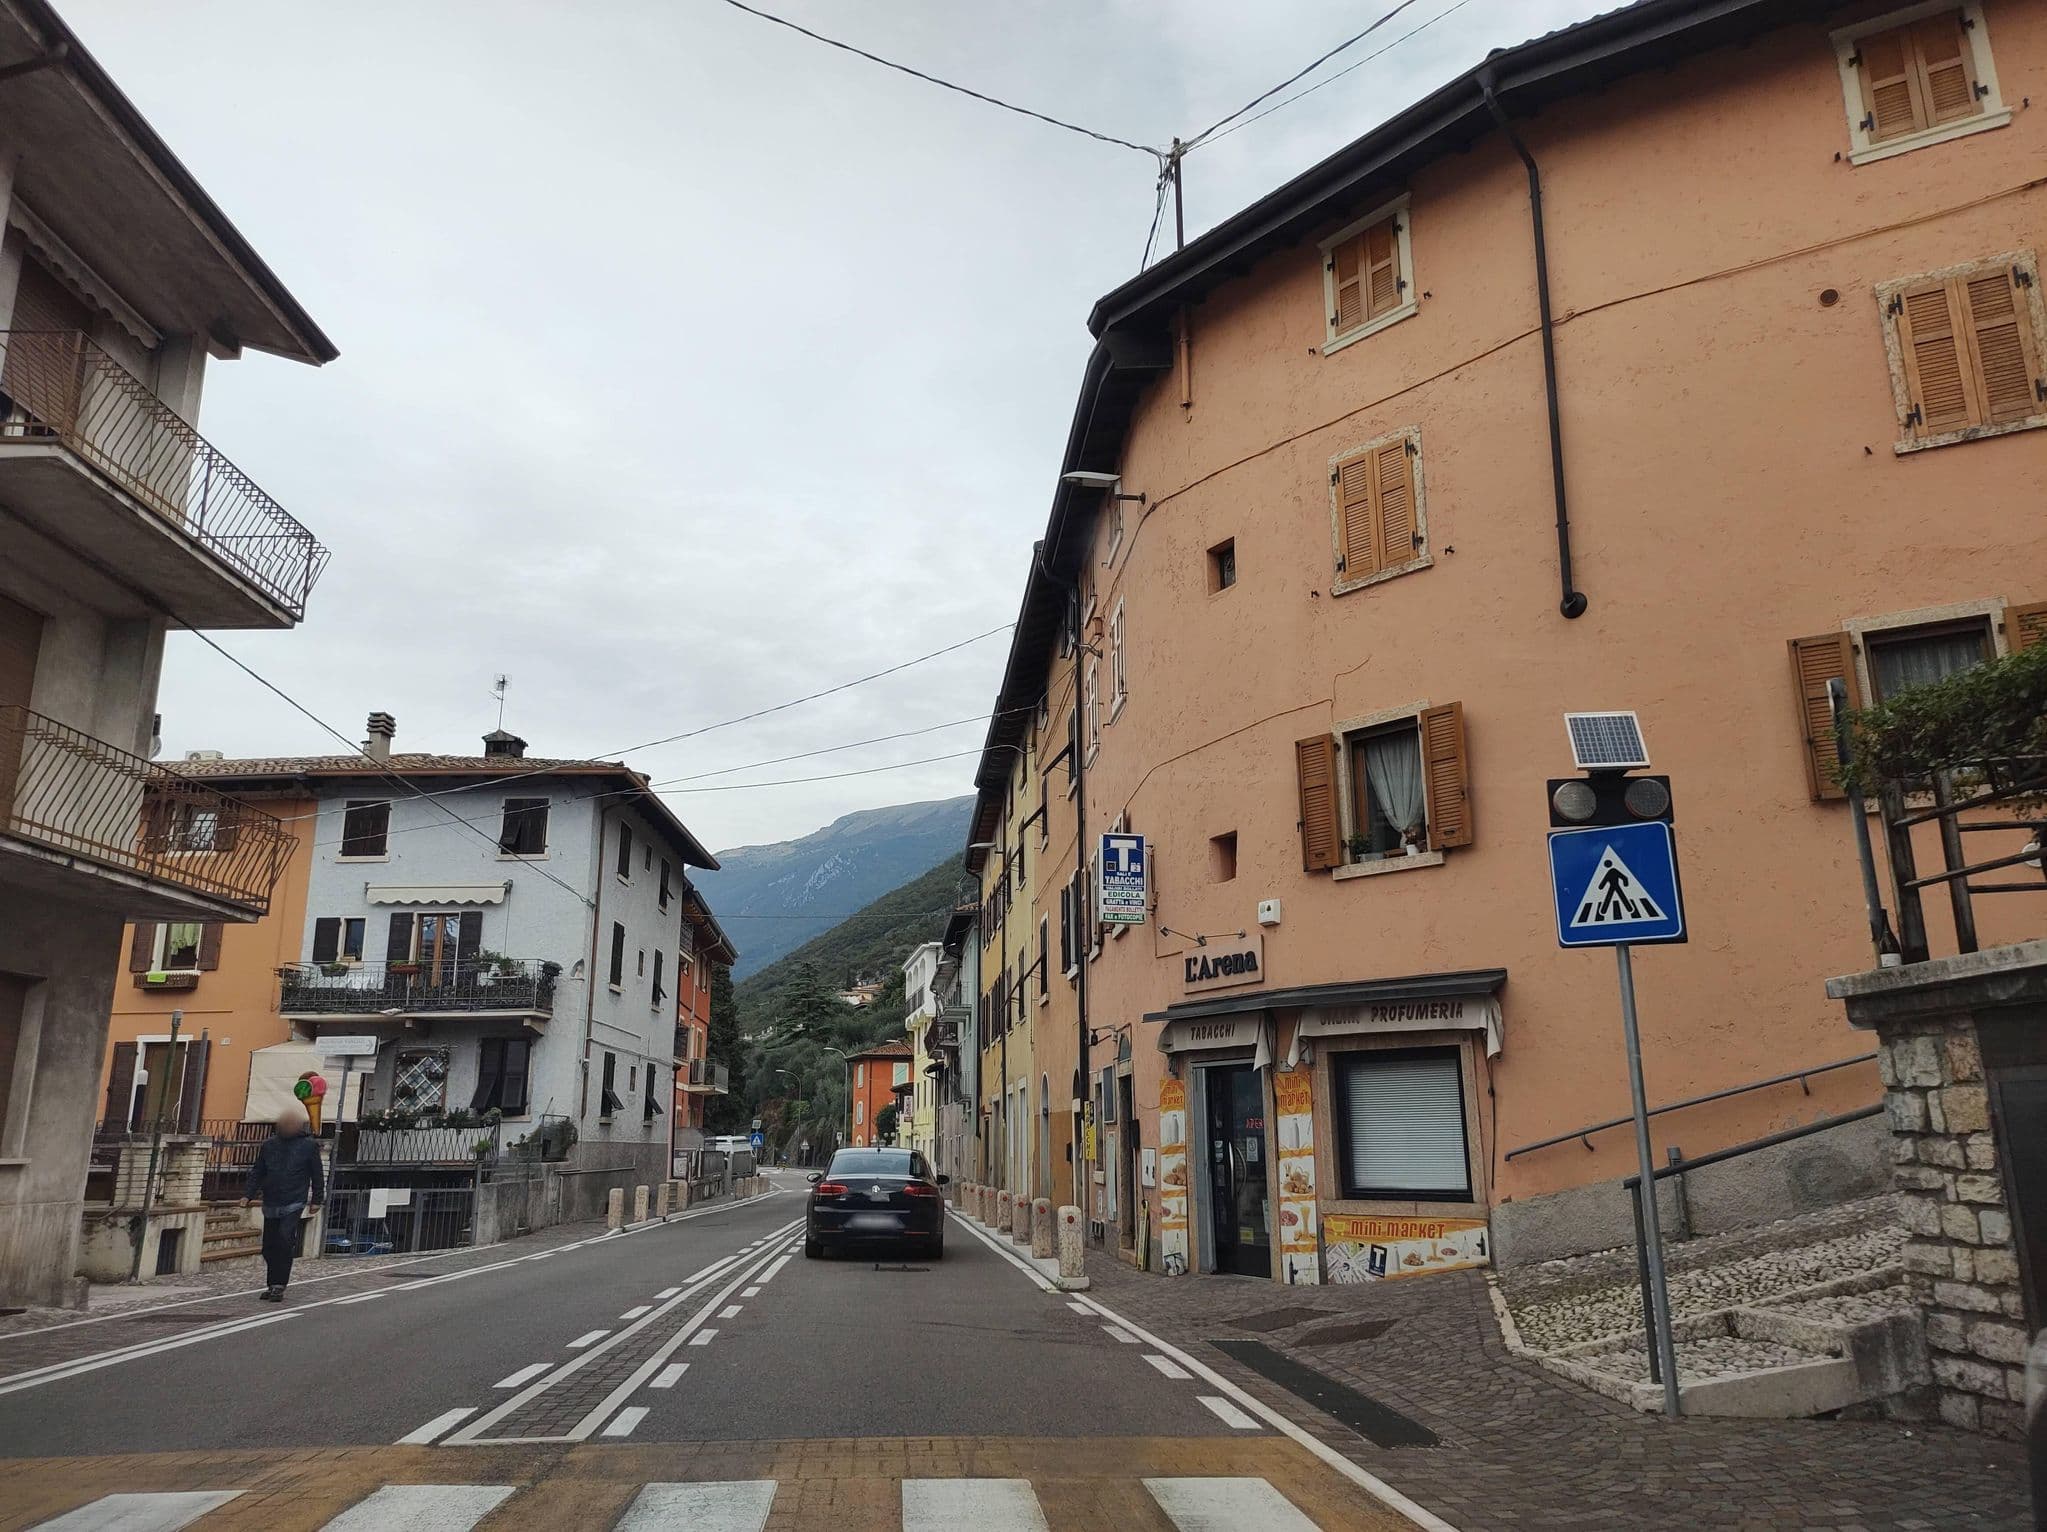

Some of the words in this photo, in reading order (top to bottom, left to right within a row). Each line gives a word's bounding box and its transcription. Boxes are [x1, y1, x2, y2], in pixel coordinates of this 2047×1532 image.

[1104, 875, 1143, 886] TABACCHI
[1185, 951, 1259, 983] L'Arena
[1371, 1002, 1464, 1023] PROFUMERIA
[1190, 1023, 1236, 1041] TABACCHI
[1280, 1090, 1309, 1107] market
[1350, 1220, 1382, 1237] mini
[1386, 1221, 1446, 1239] market
